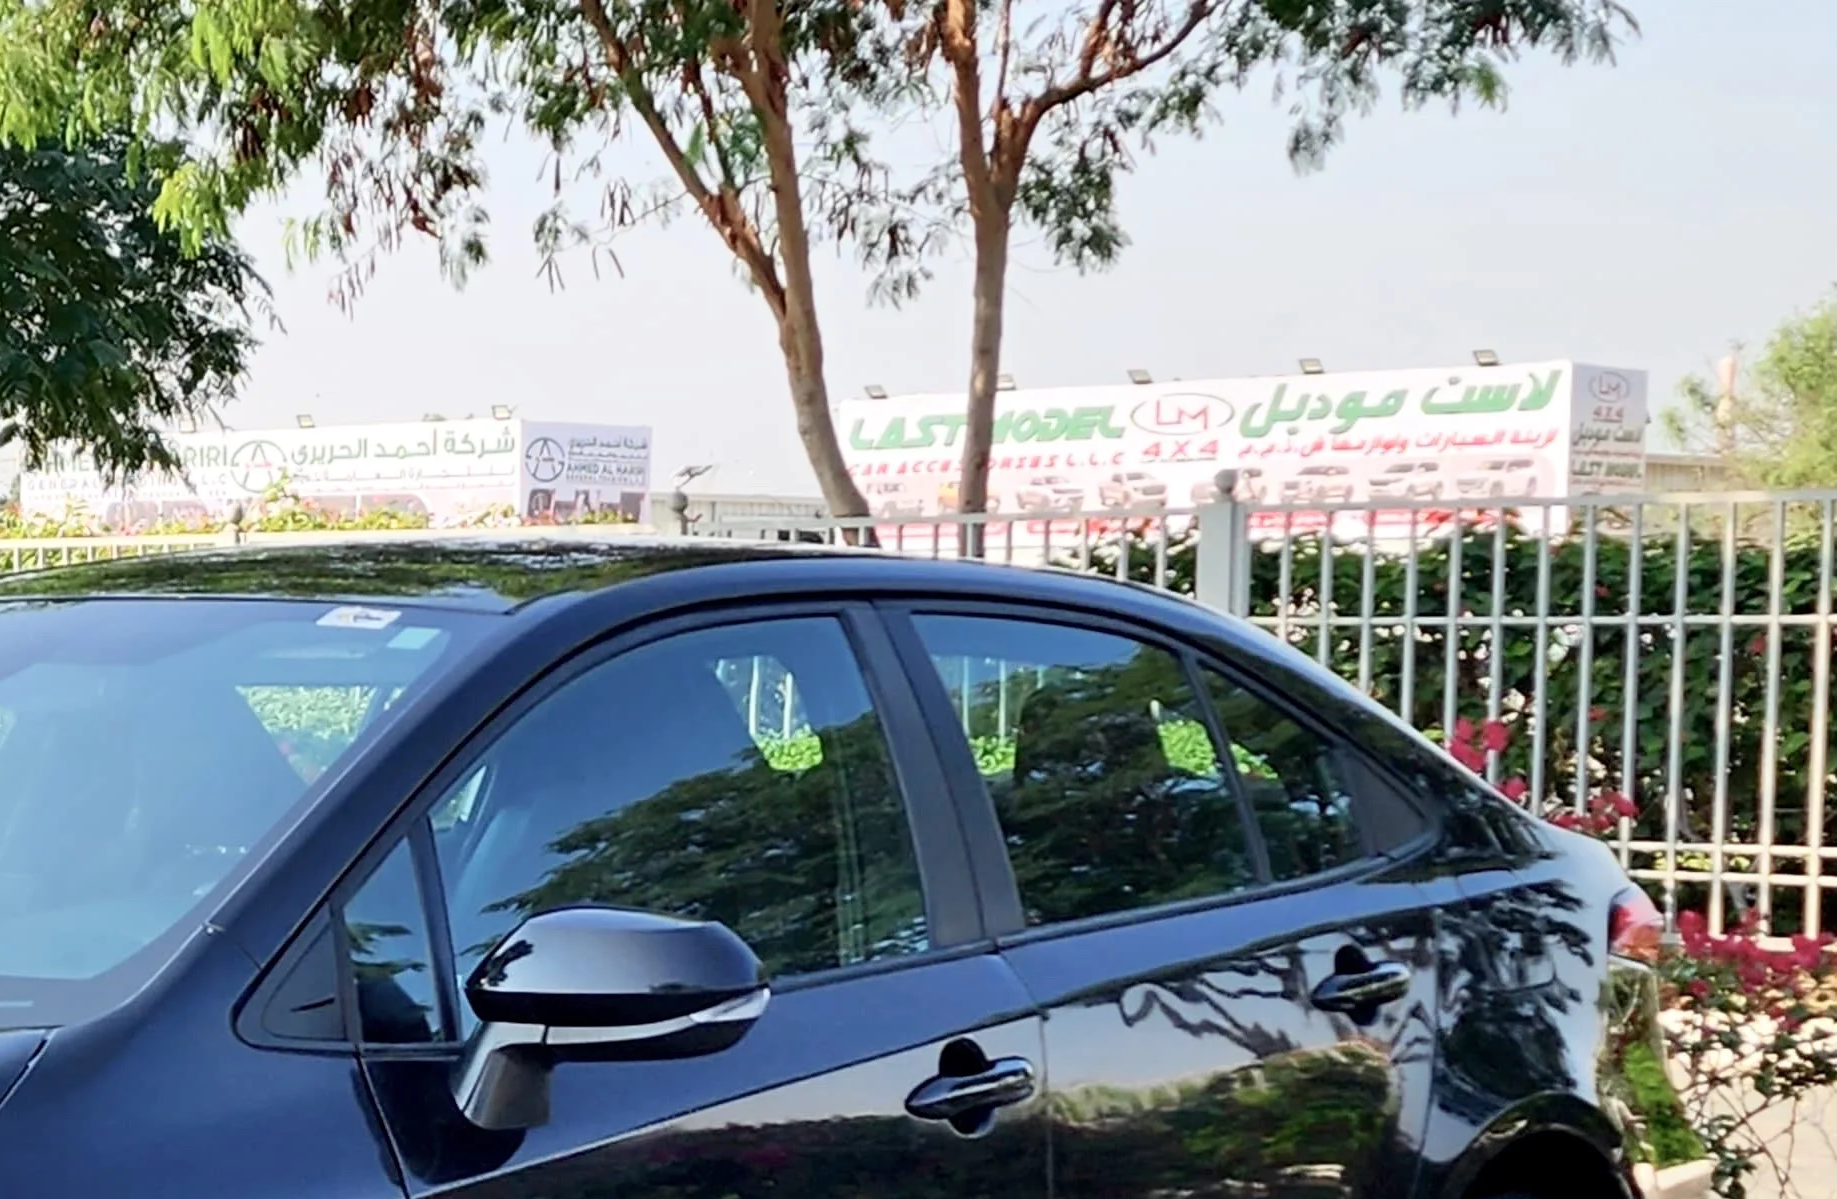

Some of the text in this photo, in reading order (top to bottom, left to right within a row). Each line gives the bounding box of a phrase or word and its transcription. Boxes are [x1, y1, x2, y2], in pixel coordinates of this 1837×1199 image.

[1154, 397, 1211, 430] LM
[1238, 368, 1563, 439] لاست موديل
[444, 426, 516, 459] شركة
[849, 412, 970, 451] LAST
